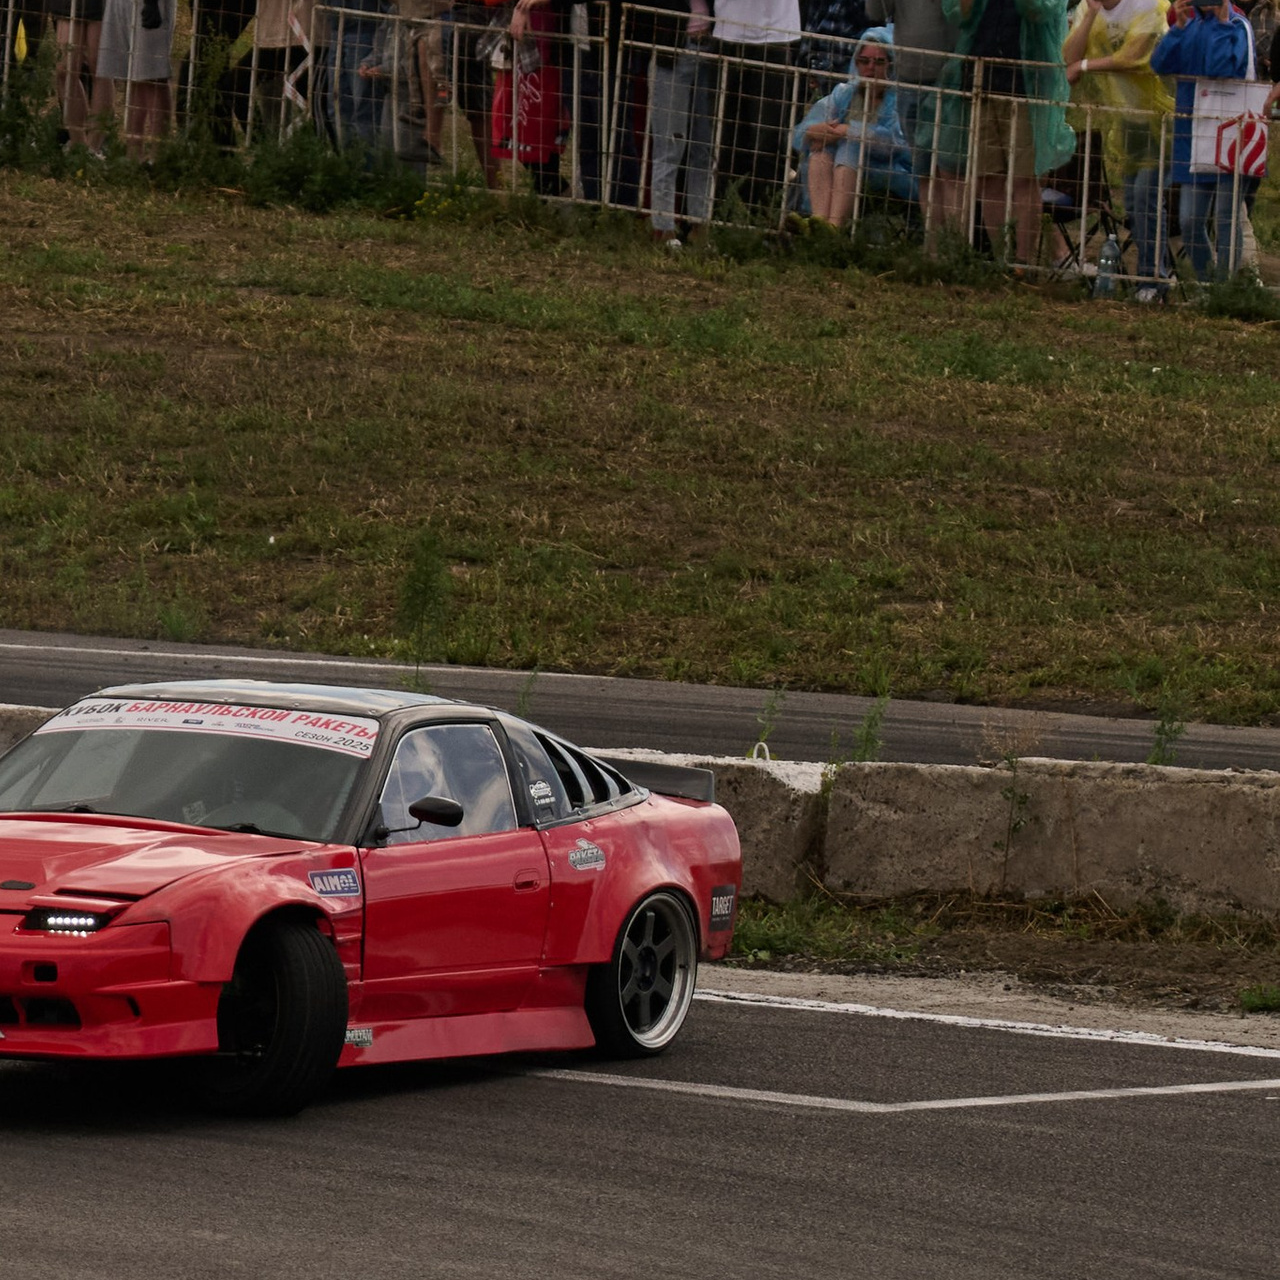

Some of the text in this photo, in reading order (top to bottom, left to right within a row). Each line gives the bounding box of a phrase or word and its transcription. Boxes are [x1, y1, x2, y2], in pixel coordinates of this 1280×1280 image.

[58, 702, 128, 718] КУБОК
[126, 702, 292, 722] БАРНАУЛЬСКОЙ
[291, 713, 379, 741] РАКЕТЫ
[294, 730, 373, 752] СЕЗОН 2025
[314, 874, 357, 892] AIMOL
